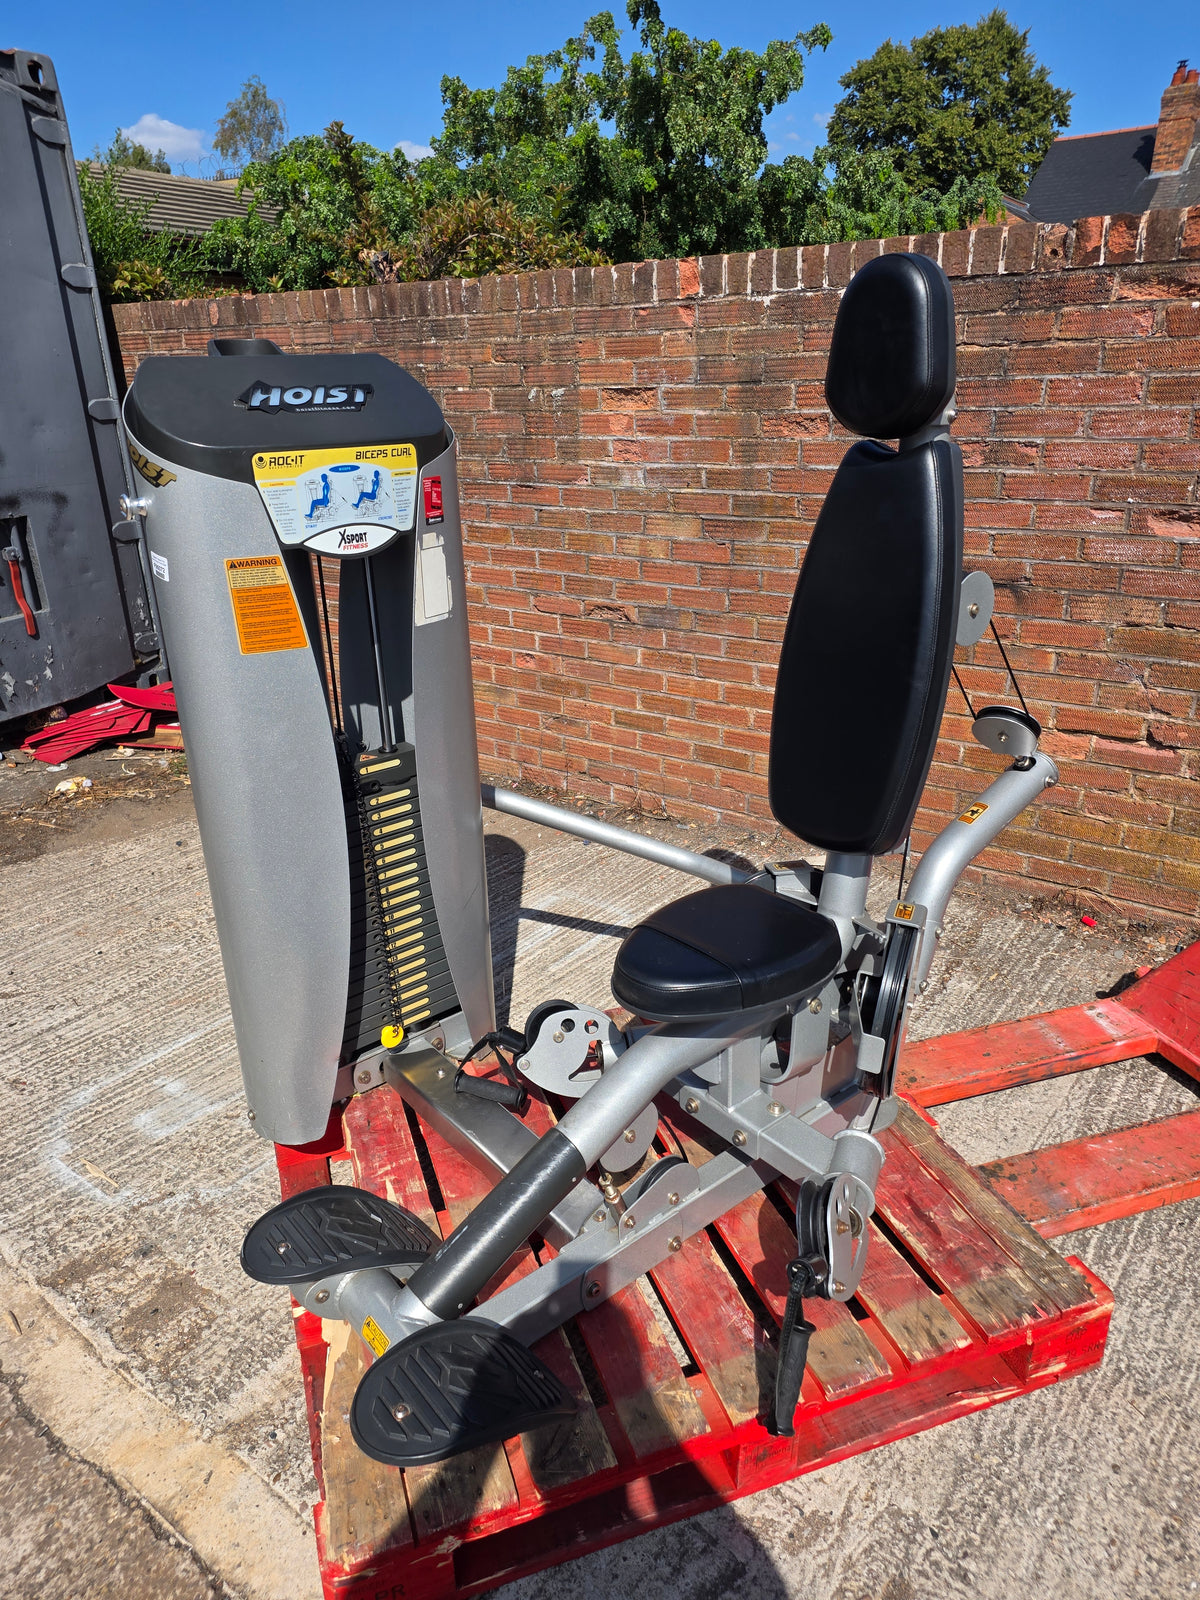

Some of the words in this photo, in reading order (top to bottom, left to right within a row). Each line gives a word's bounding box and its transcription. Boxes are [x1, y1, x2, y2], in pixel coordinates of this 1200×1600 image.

[250, 385, 374, 407] HOIST
[355, 448, 388, 460] BICEPS
[391, 447, 412, 458] CURL
[127, 439, 178, 488] OIST
[342, 542, 369, 551] FITNESS
[236, 558, 278, 568] WARNING
